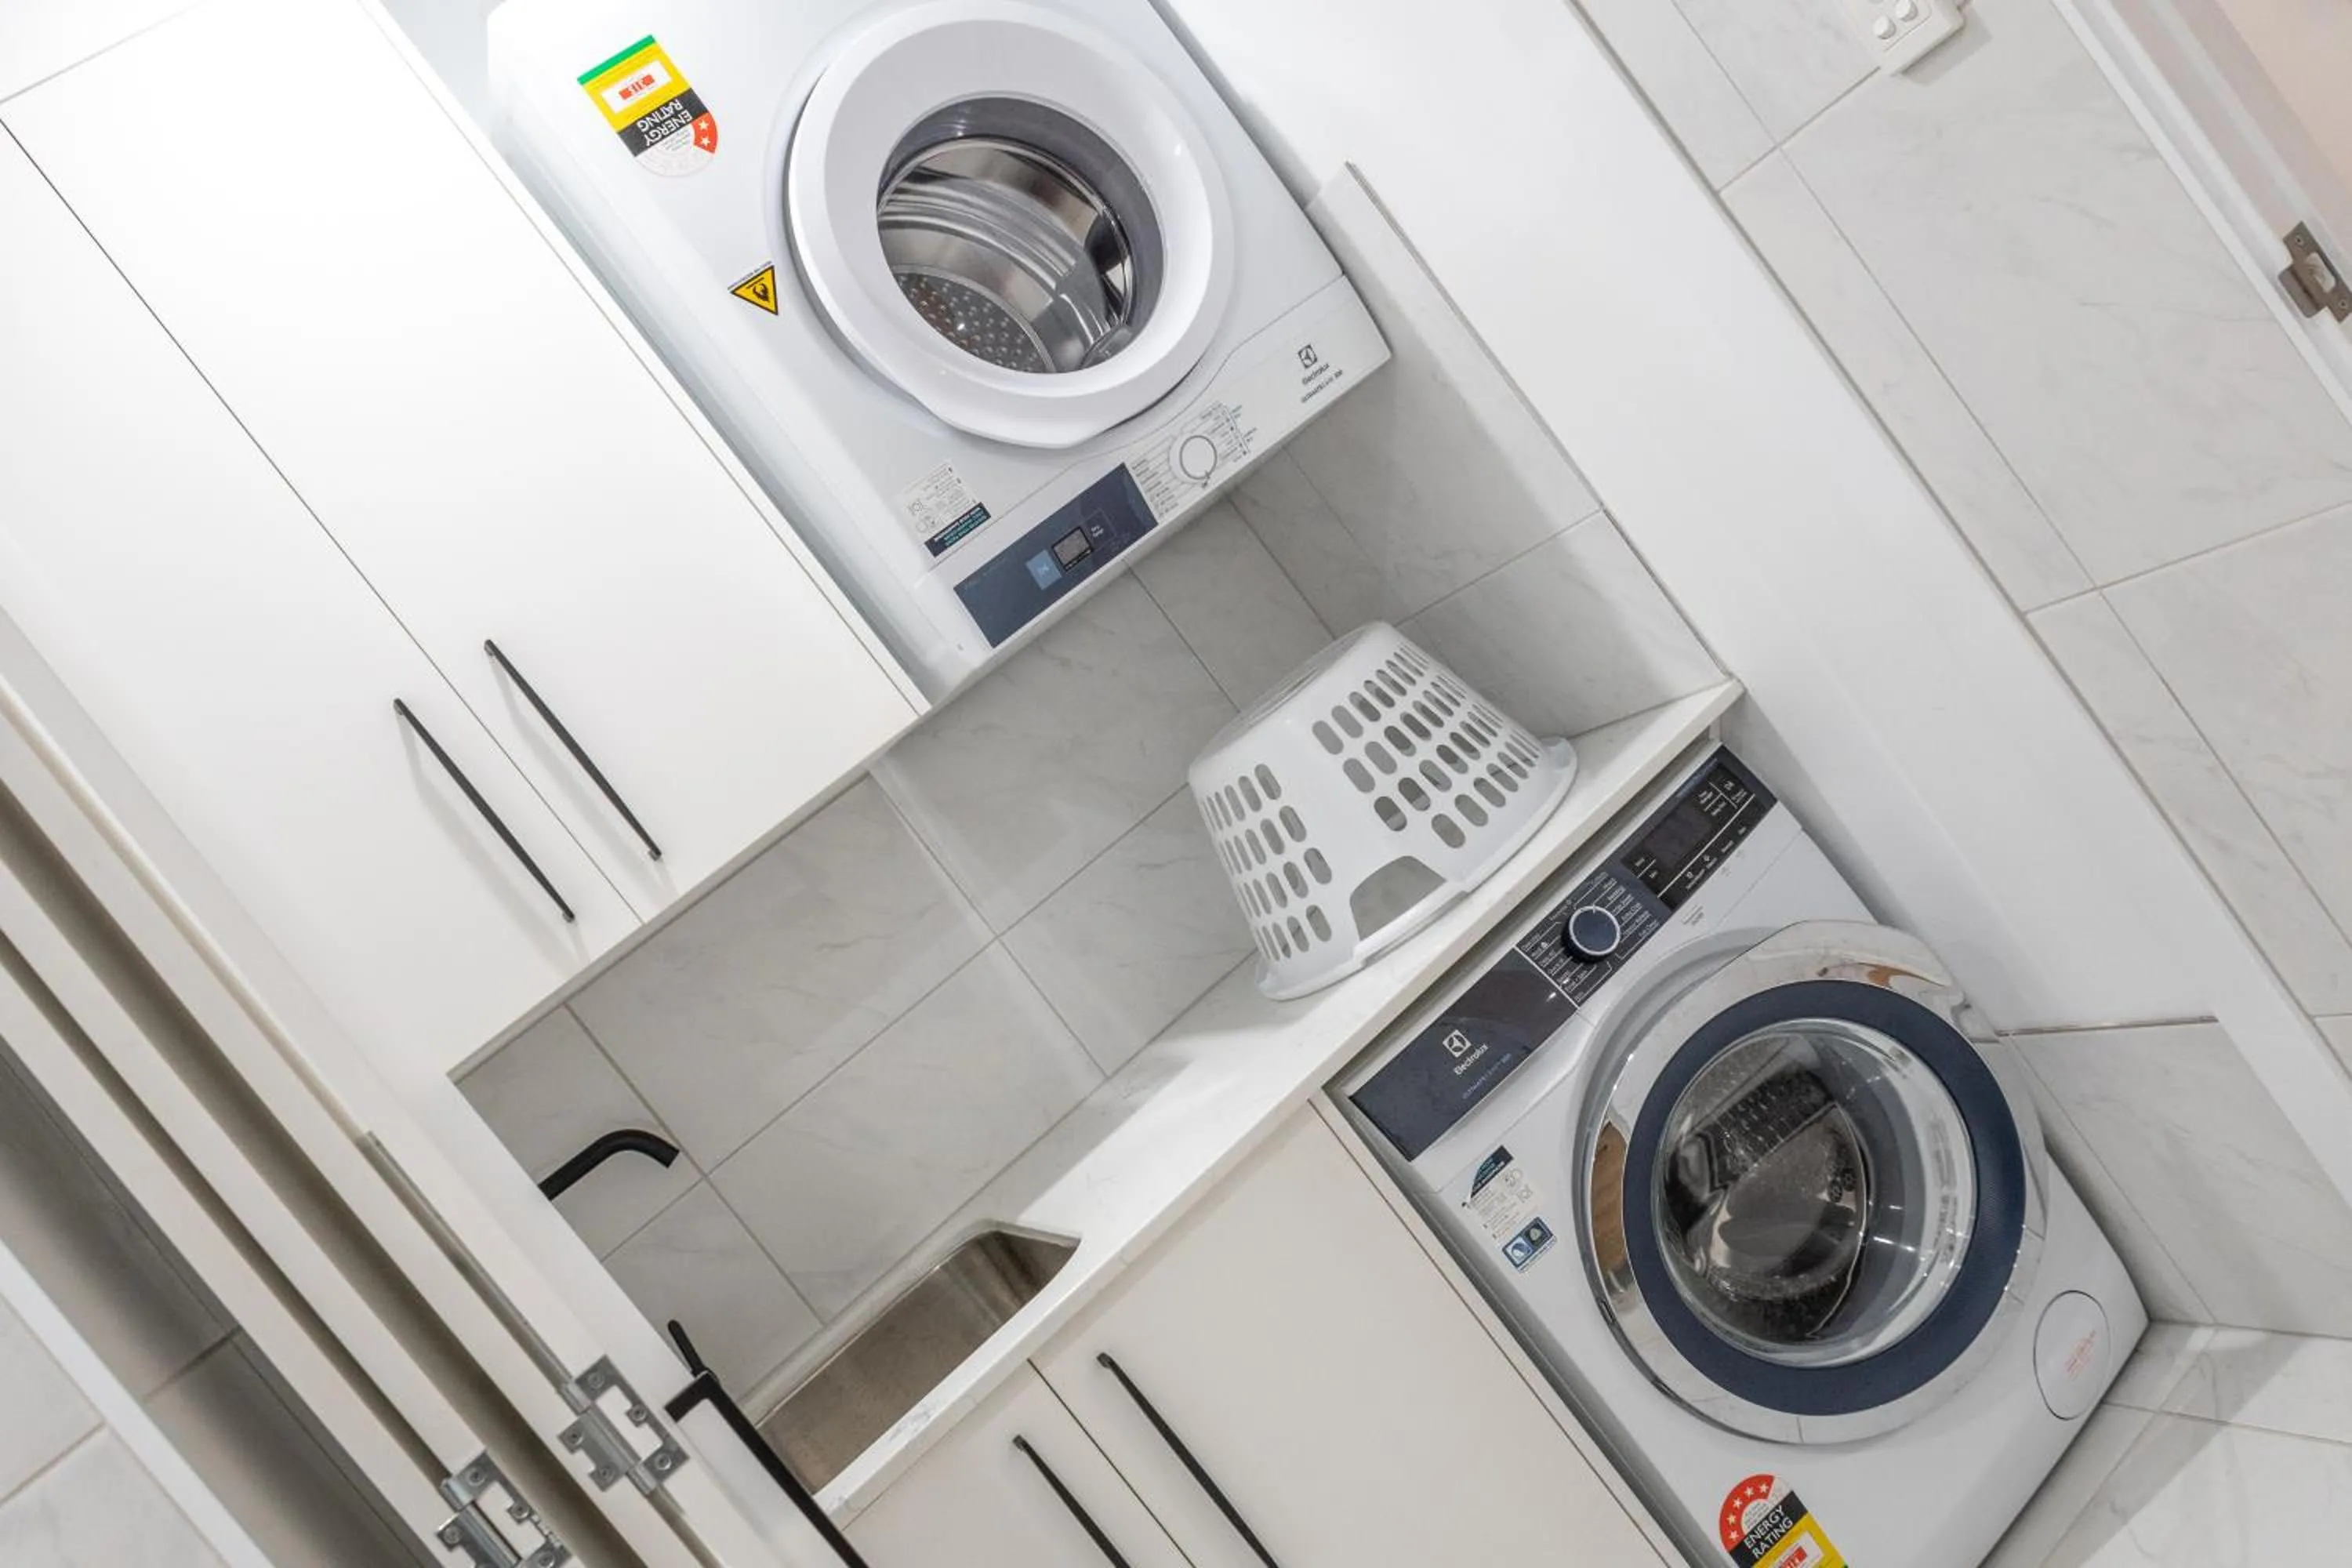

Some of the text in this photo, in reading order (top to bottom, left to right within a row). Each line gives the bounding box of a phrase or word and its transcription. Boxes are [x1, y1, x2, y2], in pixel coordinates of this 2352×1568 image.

[637, 100, 684, 132] RATING
[644, 110, 692, 147] ENERGY
[1452, 1043, 1489, 1076] Electrolux
[1743, 1504, 1787, 1549] ENERGY
[1751, 1517, 1793, 1559] RATING
